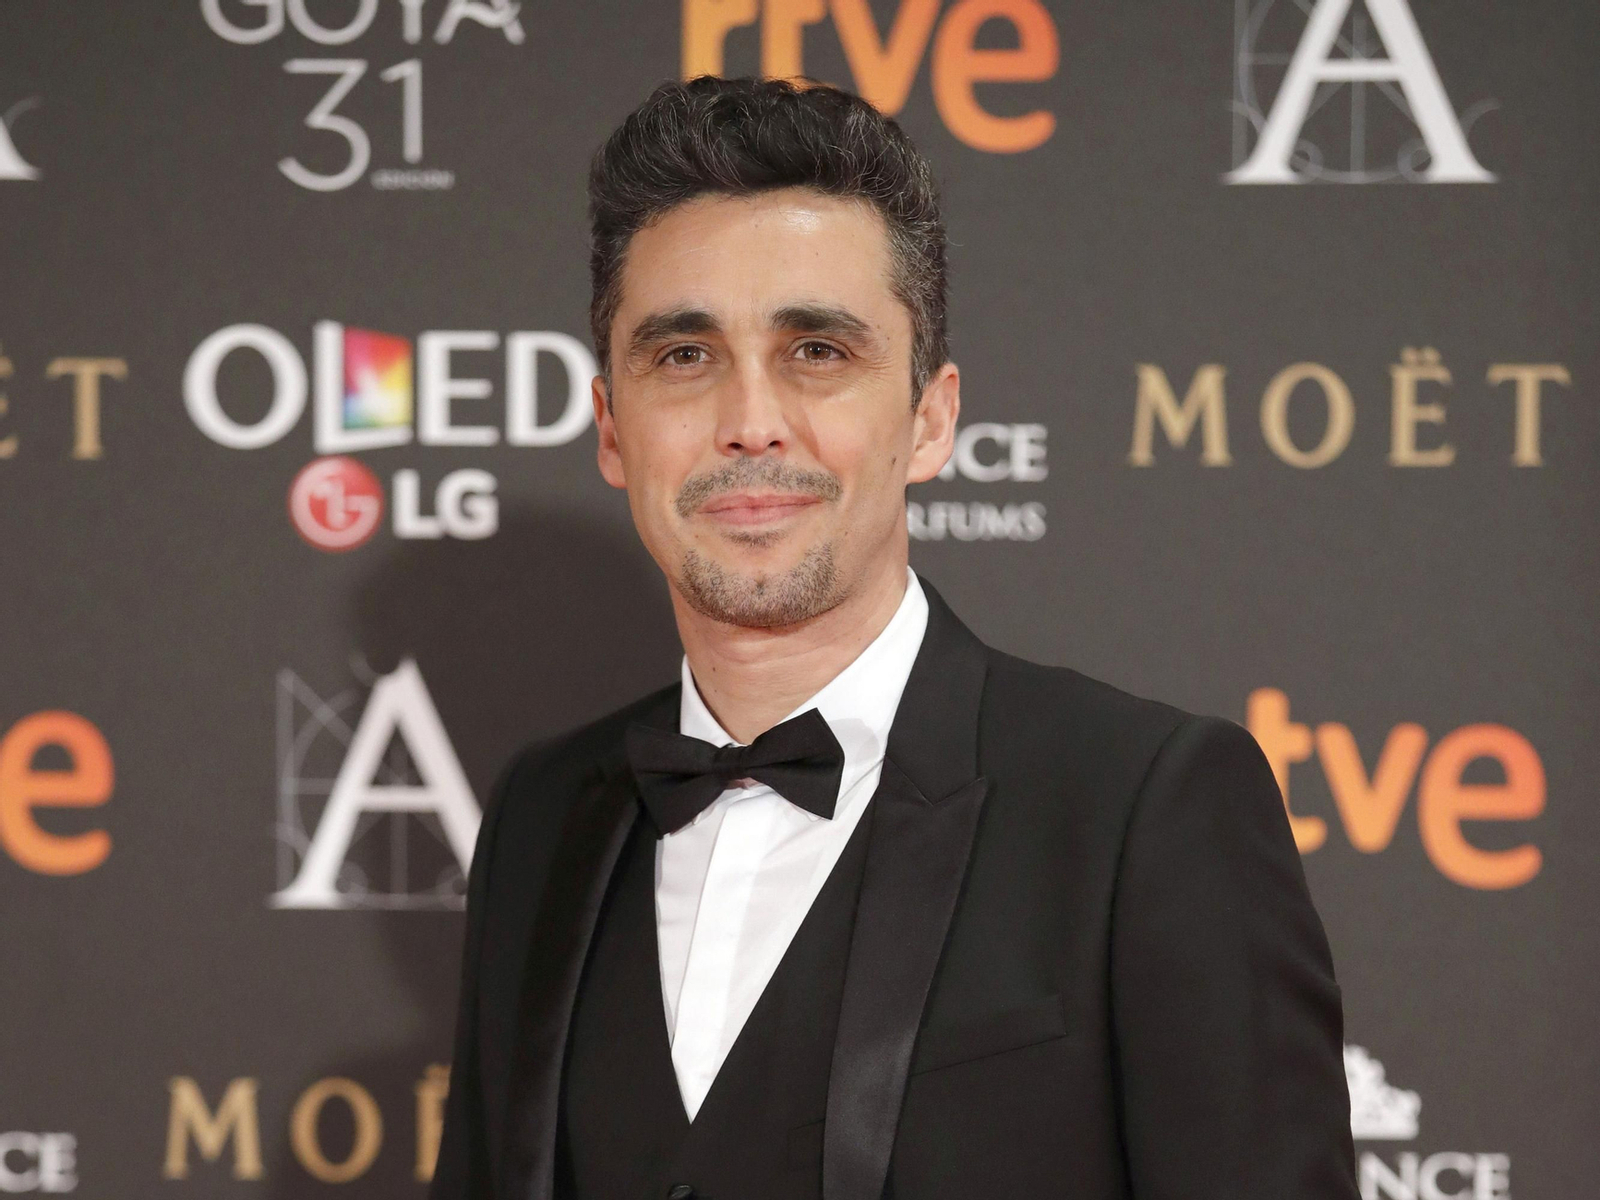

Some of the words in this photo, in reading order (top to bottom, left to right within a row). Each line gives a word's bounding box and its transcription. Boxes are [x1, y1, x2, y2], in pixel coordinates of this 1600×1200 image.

[277, 57, 425, 193] 31
[680, 0, 1061, 154] rtve
[181, 319, 599, 455] OLED
[938, 421, 1050, 483] CE
[1128, 347, 1573, 471] MOËT
[391, 467, 500, 541] LG
